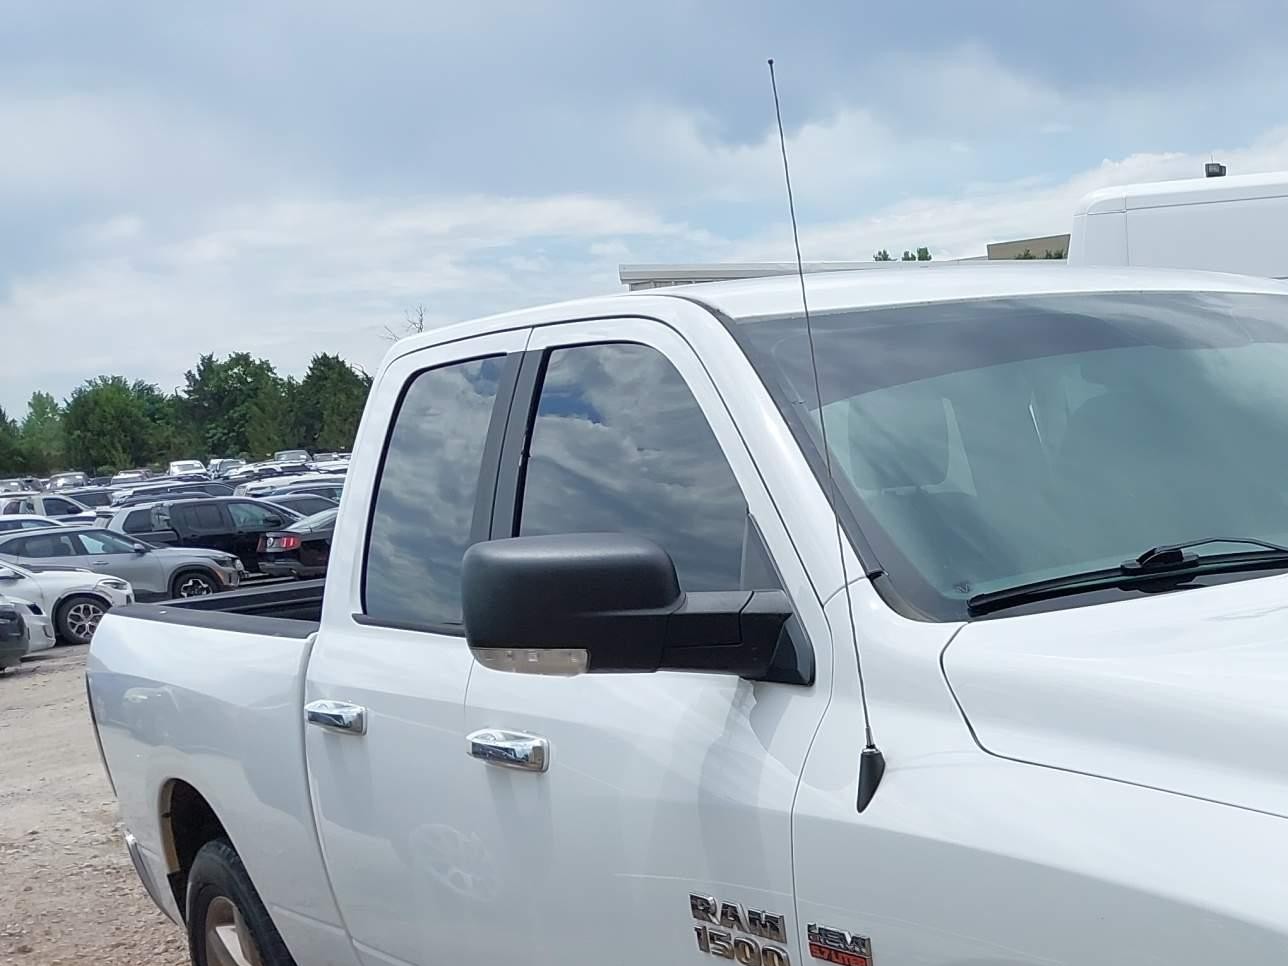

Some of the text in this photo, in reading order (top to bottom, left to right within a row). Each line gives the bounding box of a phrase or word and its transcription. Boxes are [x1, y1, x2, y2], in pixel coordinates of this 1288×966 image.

[689, 893, 787, 943] RAM
[807, 921, 872, 958] HEMI
[810, 943, 830, 960] 5.7
